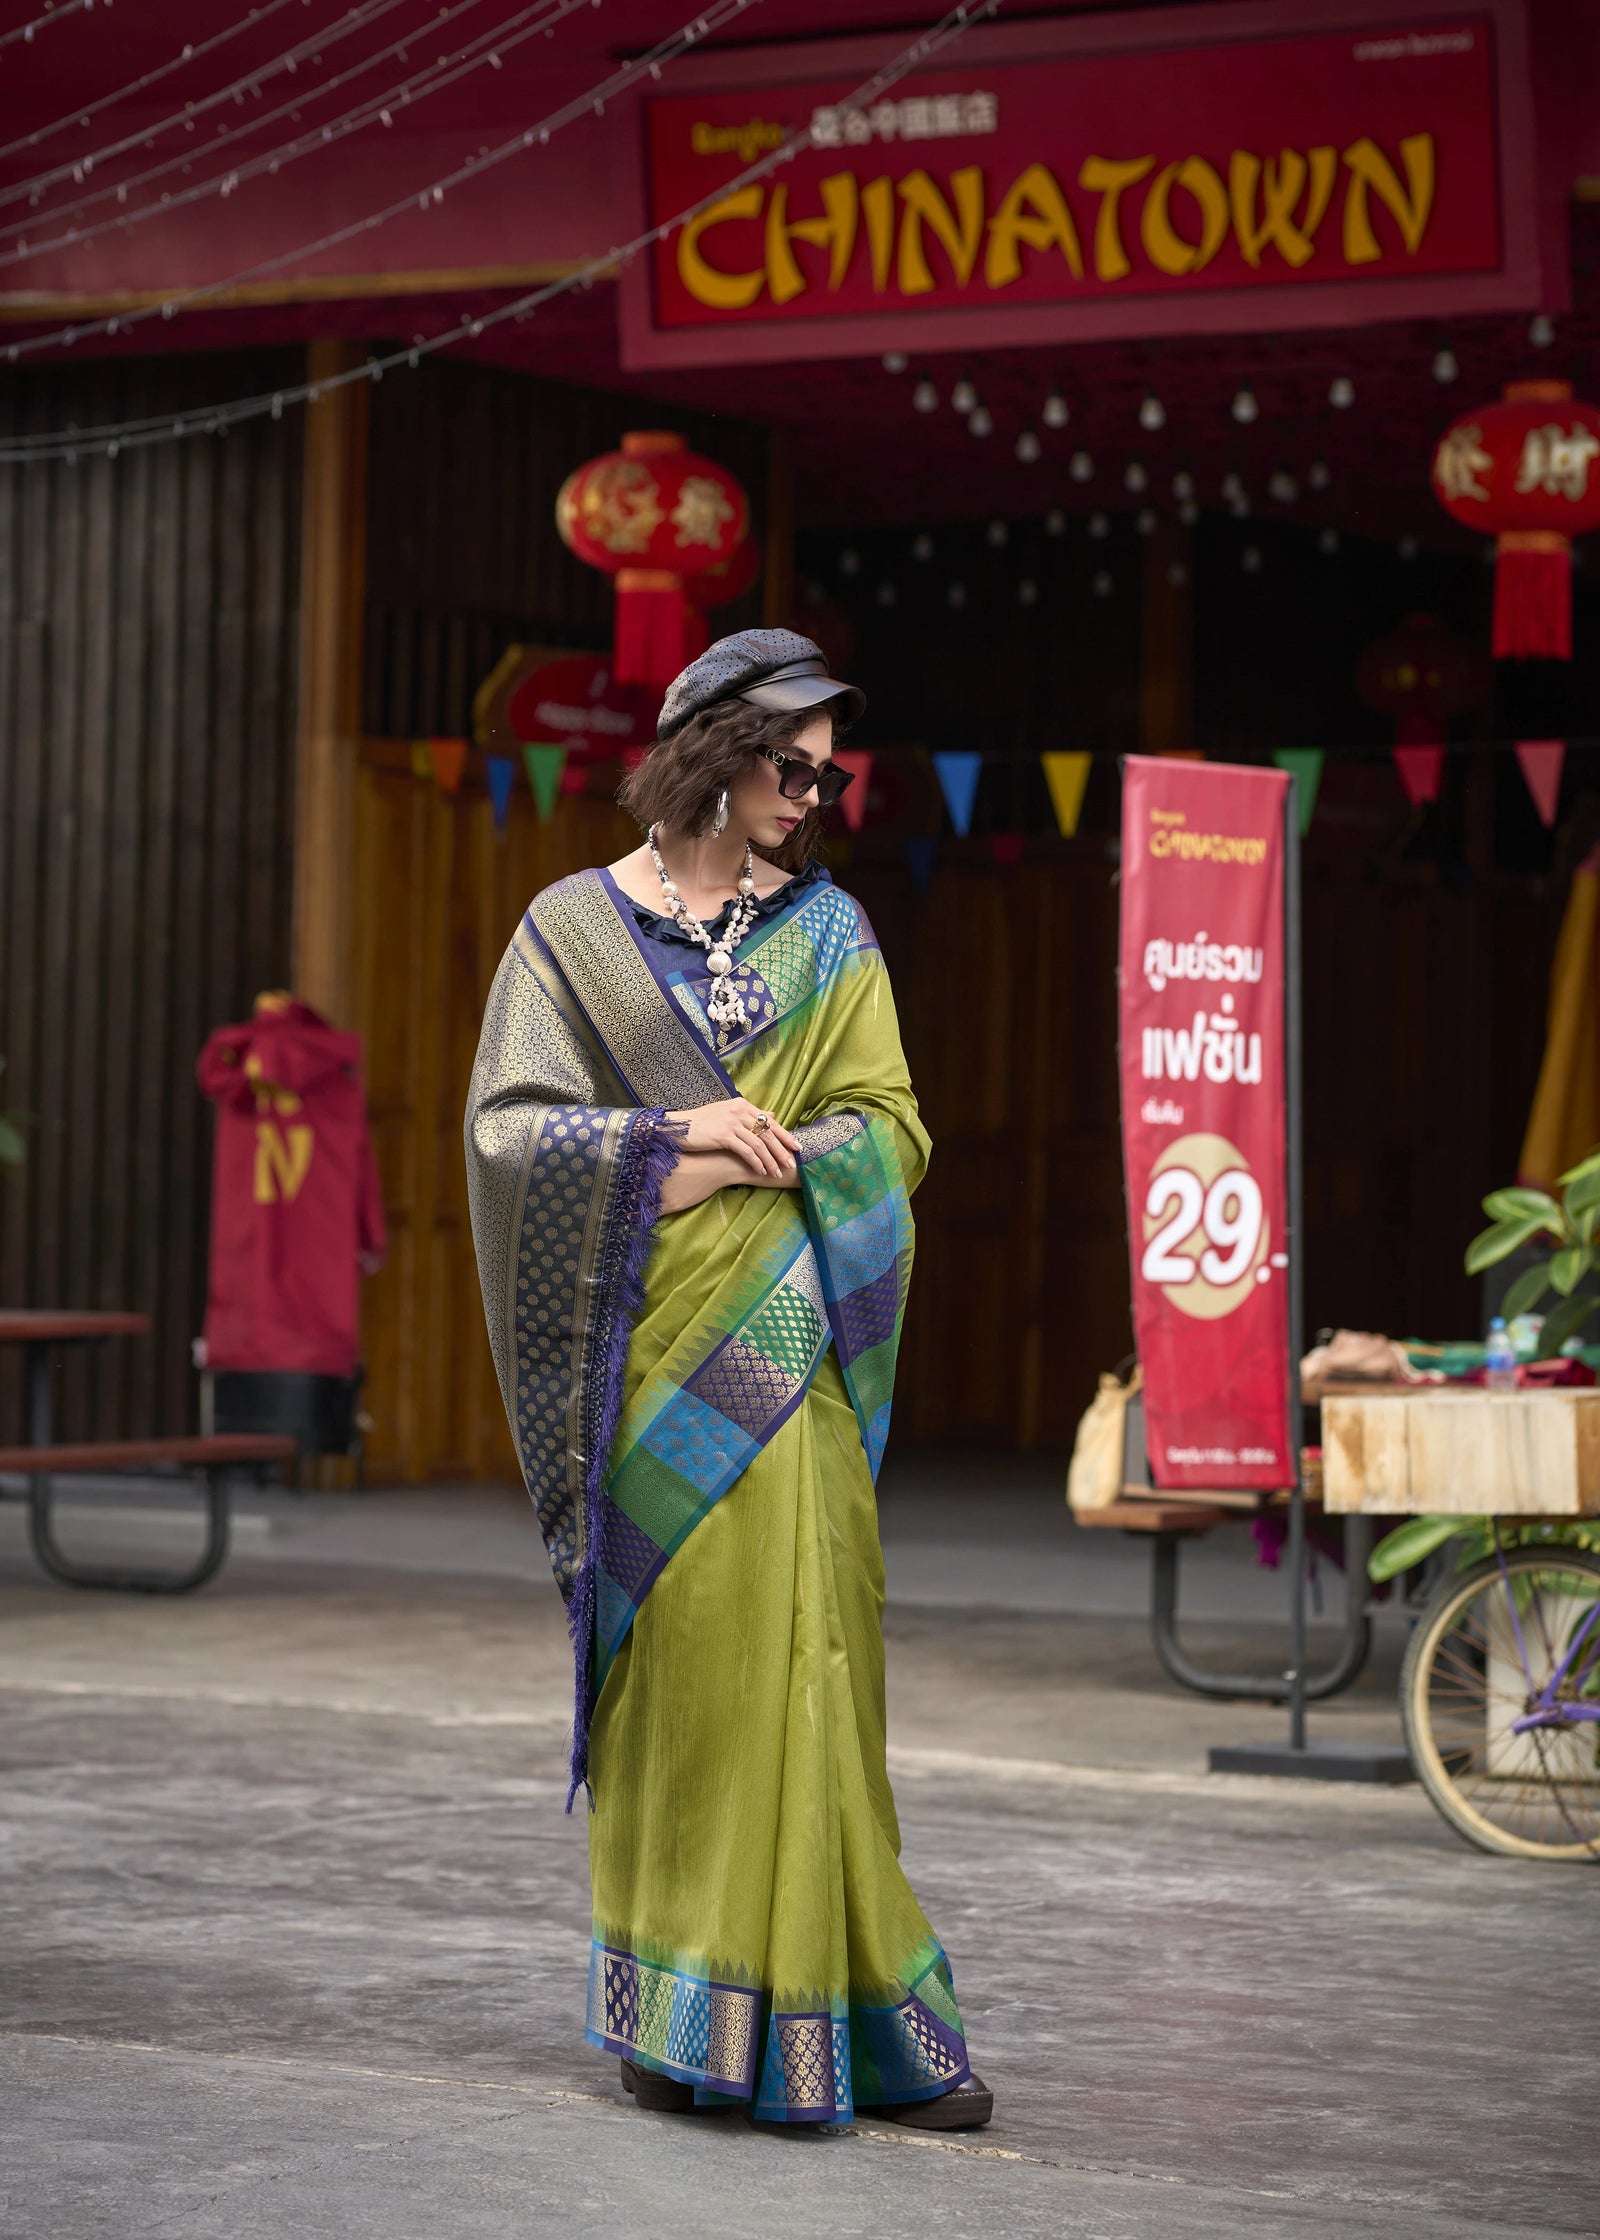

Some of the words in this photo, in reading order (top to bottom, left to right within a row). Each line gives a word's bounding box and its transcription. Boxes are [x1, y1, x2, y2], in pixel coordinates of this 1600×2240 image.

[692, 118, 794, 162] Bangko
[677, 133, 1434, 309] CHINATOWN
[1144, 930, 1263, 992] ศูนย์รวม
[1142, 992, 1262, 1085] แฟชั่น
